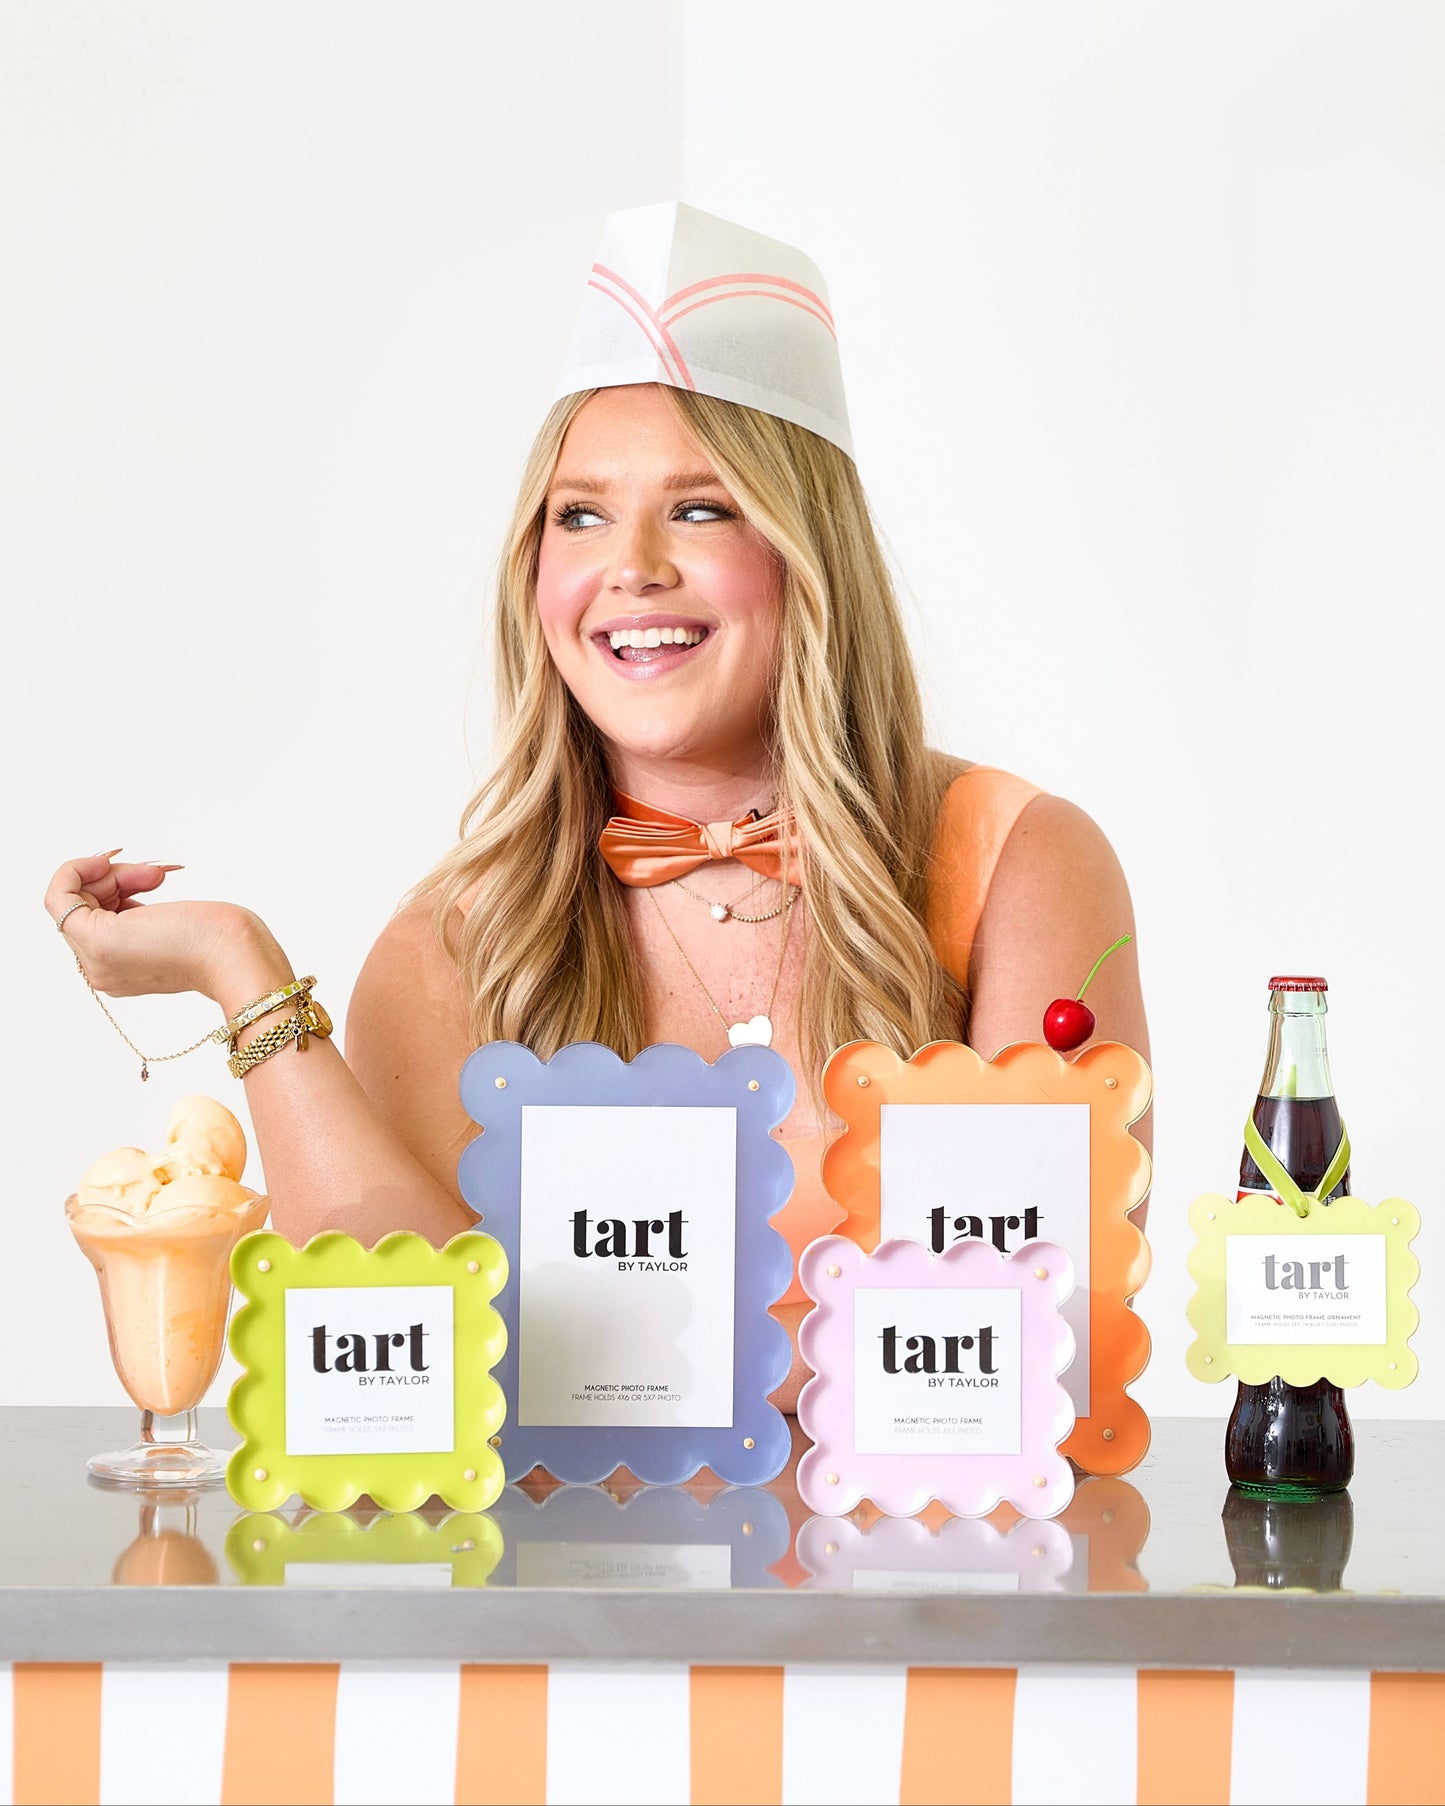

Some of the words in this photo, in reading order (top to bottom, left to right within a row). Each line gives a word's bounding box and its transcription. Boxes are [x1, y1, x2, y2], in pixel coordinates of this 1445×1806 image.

[569, 1210, 688, 1258] tart
[927, 1206, 1044, 1257] tart
[618, 1262, 634, 1271] BY
[638, 1262, 688, 1272] TAYLOR
[1262, 1254, 1349, 1290] tart
[1298, 1292, 1309, 1300] BY
[1314, 1292, 1349, 1300] TAYLOR
[308, 1323, 430, 1374] tart
[878, 1326, 999, 1375] tart
[359, 1376, 375, 1386] BY
[380, 1376, 430, 1386] TAYLOR
[928, 1378, 945, 1388] BY
[949, 1378, 999, 1388] TAYLOR
